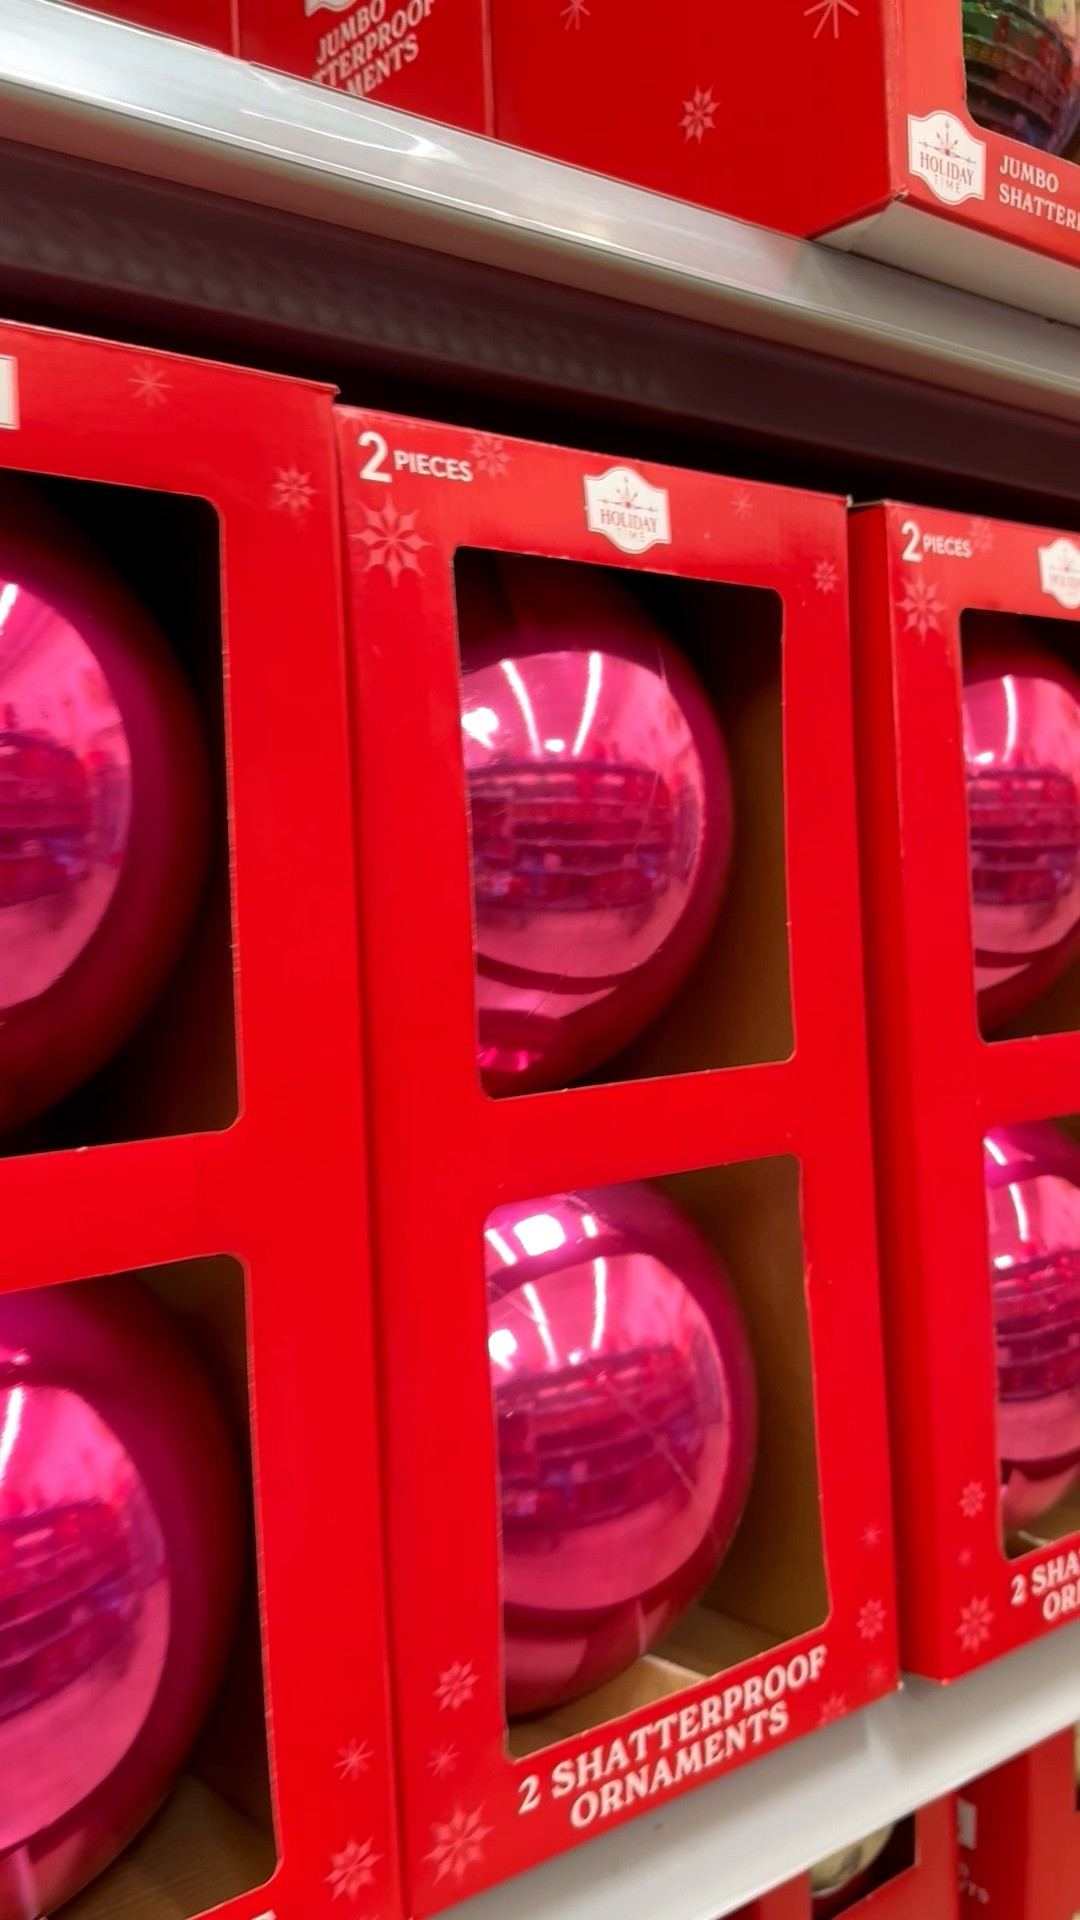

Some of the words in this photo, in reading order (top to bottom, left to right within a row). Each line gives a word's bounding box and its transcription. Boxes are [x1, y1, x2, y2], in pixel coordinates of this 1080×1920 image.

[316, 0, 386, 66] JUMBO
[919, 150, 975, 187] HOLIDAY
[933, 173, 961, 195] TIME
[1000, 155, 1059, 193] JUMBO
[358, 431, 393, 484] 2
[393, 449, 474, 483] PIECES
[600, 508, 657, 533] HOLIDAY
[901, 519, 923, 563] 2
[922, 533, 973, 559] PIECES
[1010, 1573, 1028, 1608] 2
[1031, 1548, 1080, 1597] SHA
[517, 1774, 542, 1815] 2
[551, 1644, 829, 1799] SHATTERPROOF
[570, 1700, 790, 1829] ORNAMENTS
